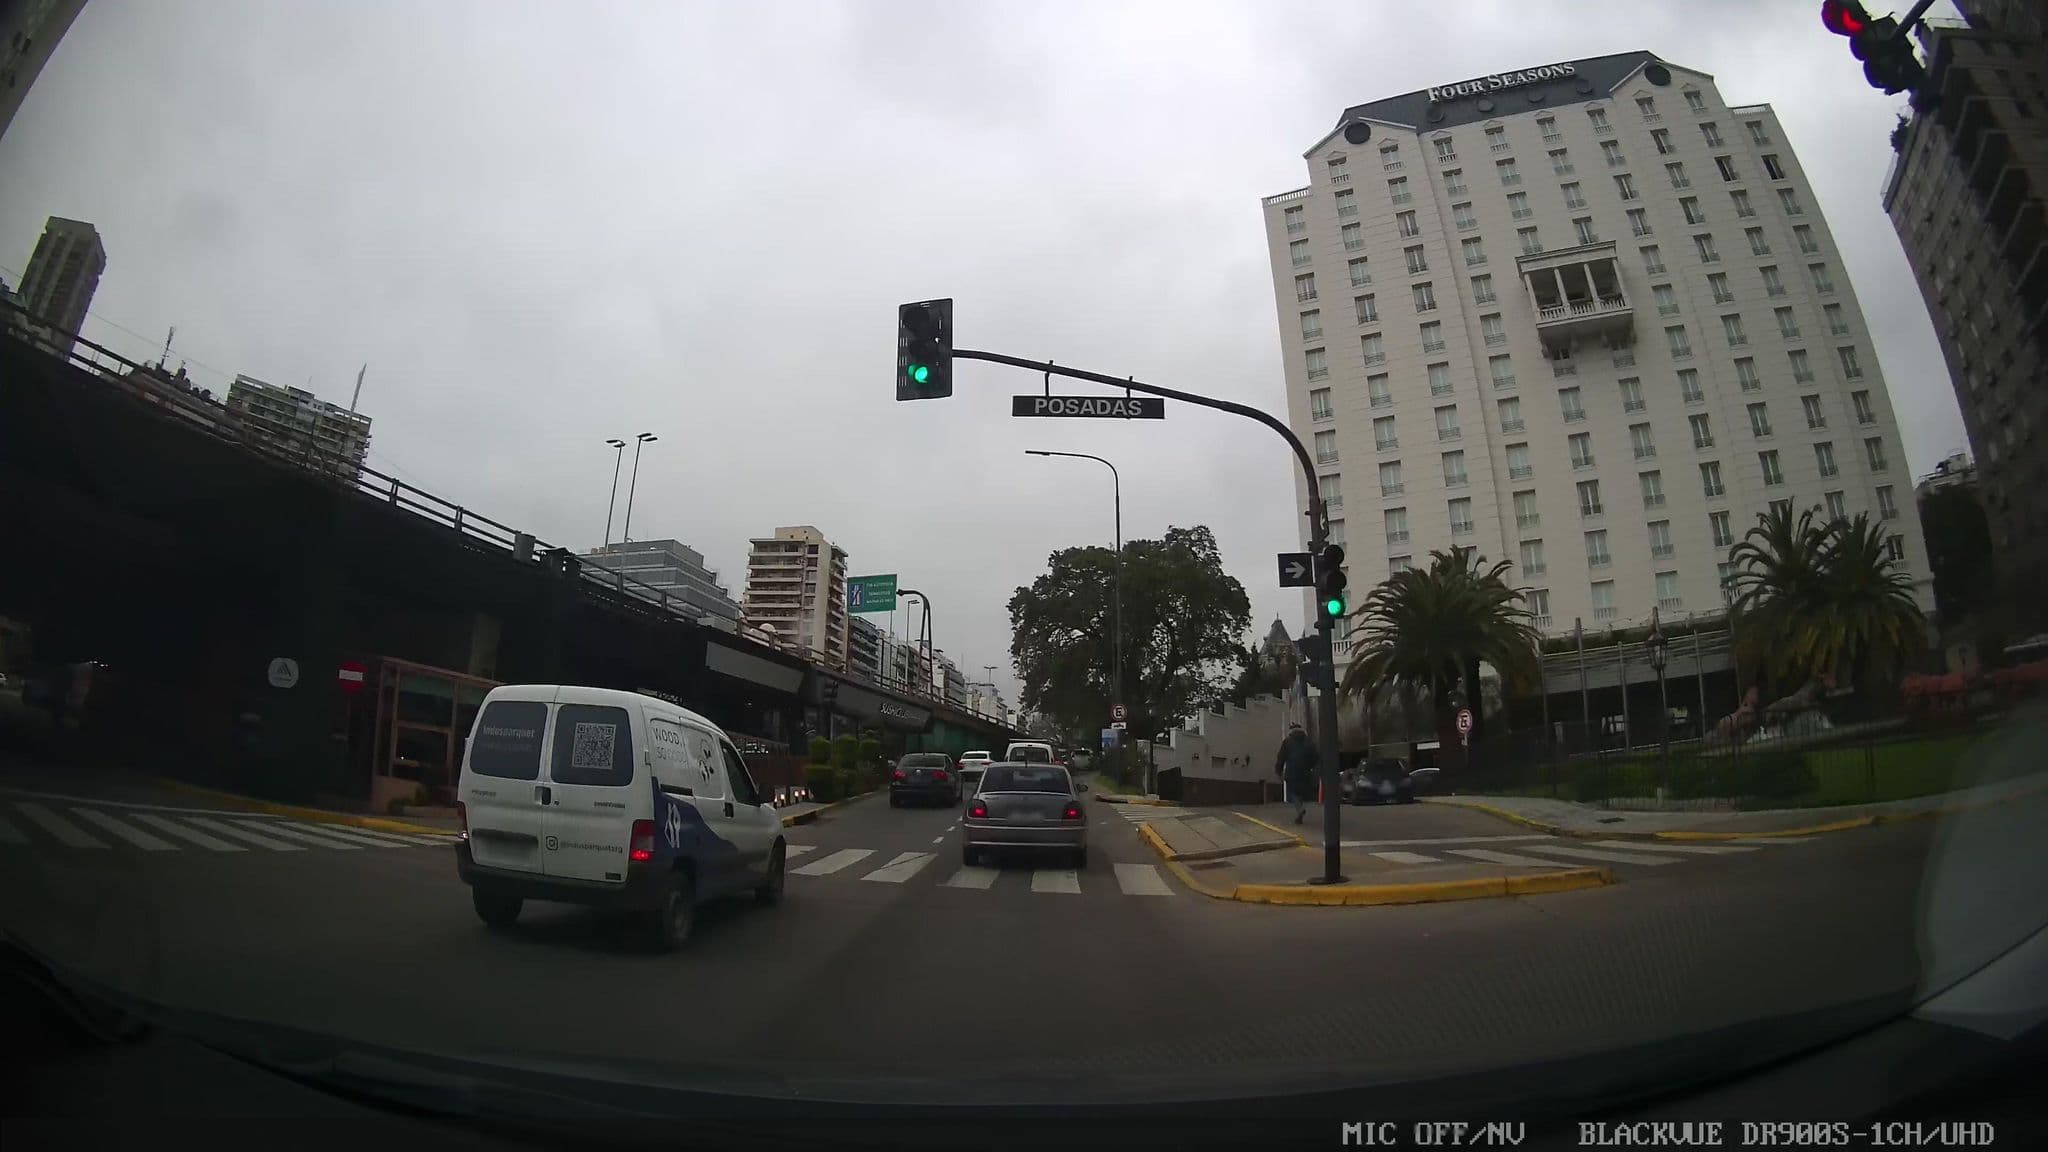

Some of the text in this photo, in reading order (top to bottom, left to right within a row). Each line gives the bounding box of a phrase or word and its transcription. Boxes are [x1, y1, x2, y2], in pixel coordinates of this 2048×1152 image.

[1427, 62, 1576, 101] FOUR SEASONS
[1034, 398, 1142, 416] POSADAS
